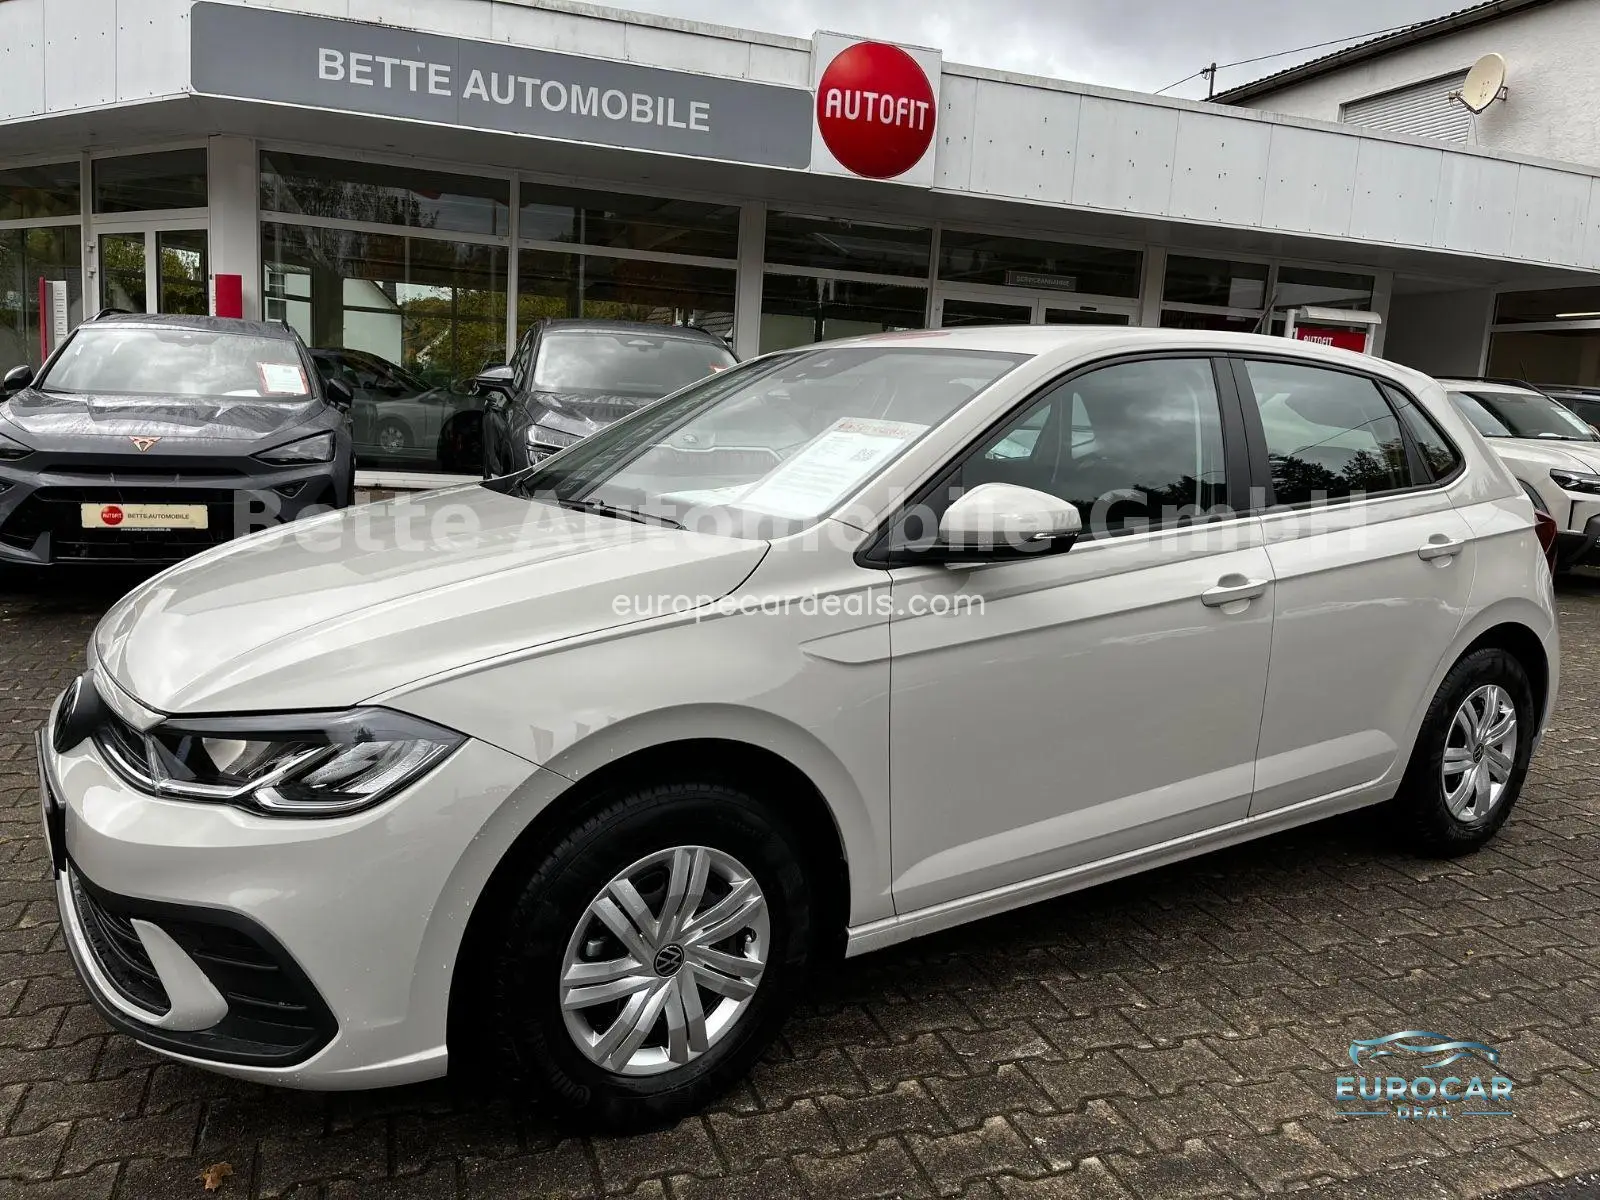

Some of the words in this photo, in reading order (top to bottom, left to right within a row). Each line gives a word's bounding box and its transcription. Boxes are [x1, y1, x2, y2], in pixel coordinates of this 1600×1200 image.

[318, 47, 452, 97] BETTE
[462, 69, 711, 132] AUTOMOBILE
[825, 88, 929, 131] AUTOFIT
